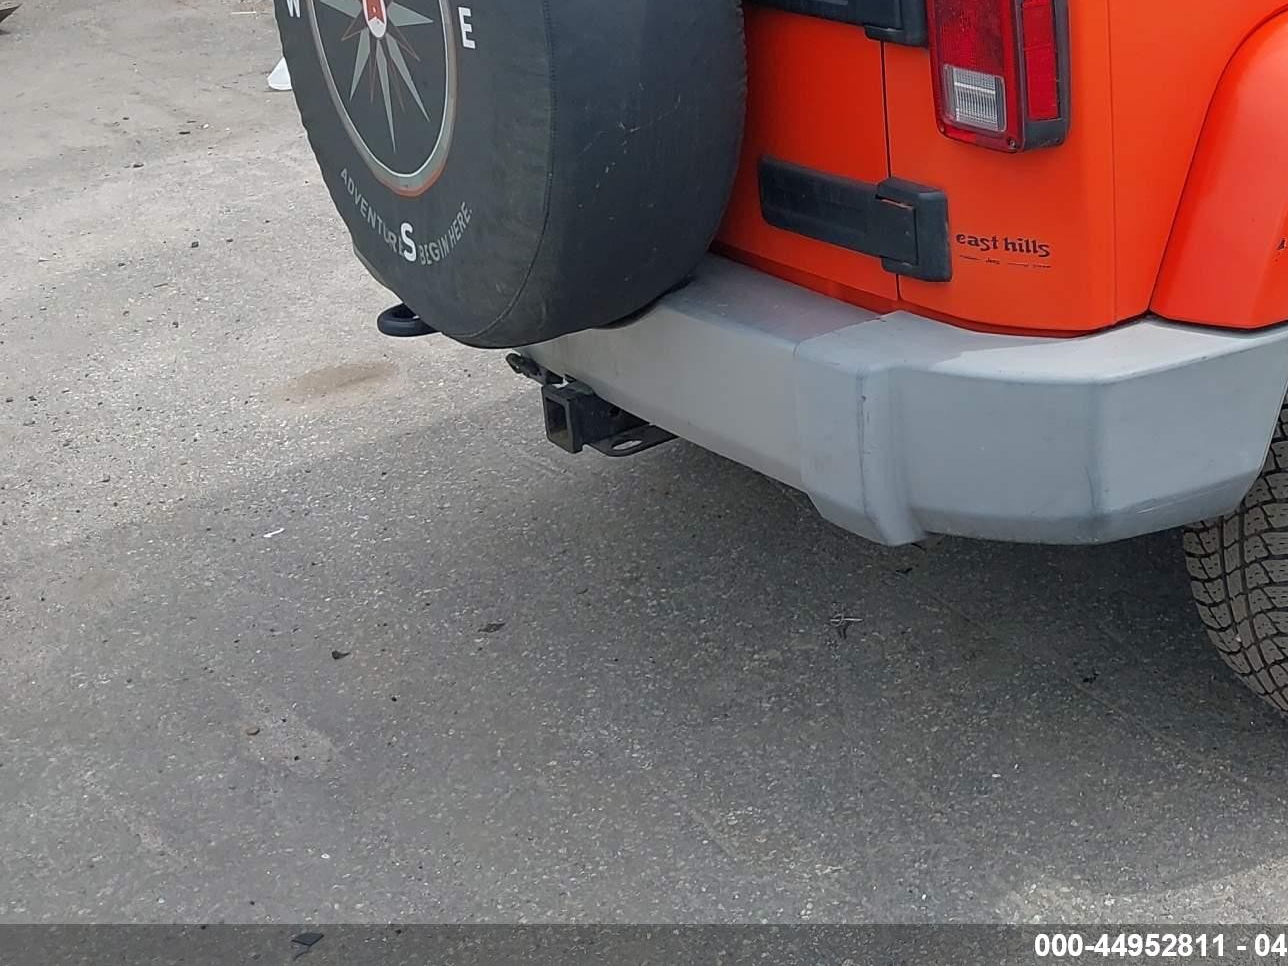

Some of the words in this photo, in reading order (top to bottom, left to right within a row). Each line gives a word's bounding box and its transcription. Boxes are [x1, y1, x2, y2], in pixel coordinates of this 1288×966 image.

[457, 6, 476, 50] E
[419, 236, 451, 266] BEGIN
[956, 234, 999, 252] east
[1004, 237, 1050, 258] hills
